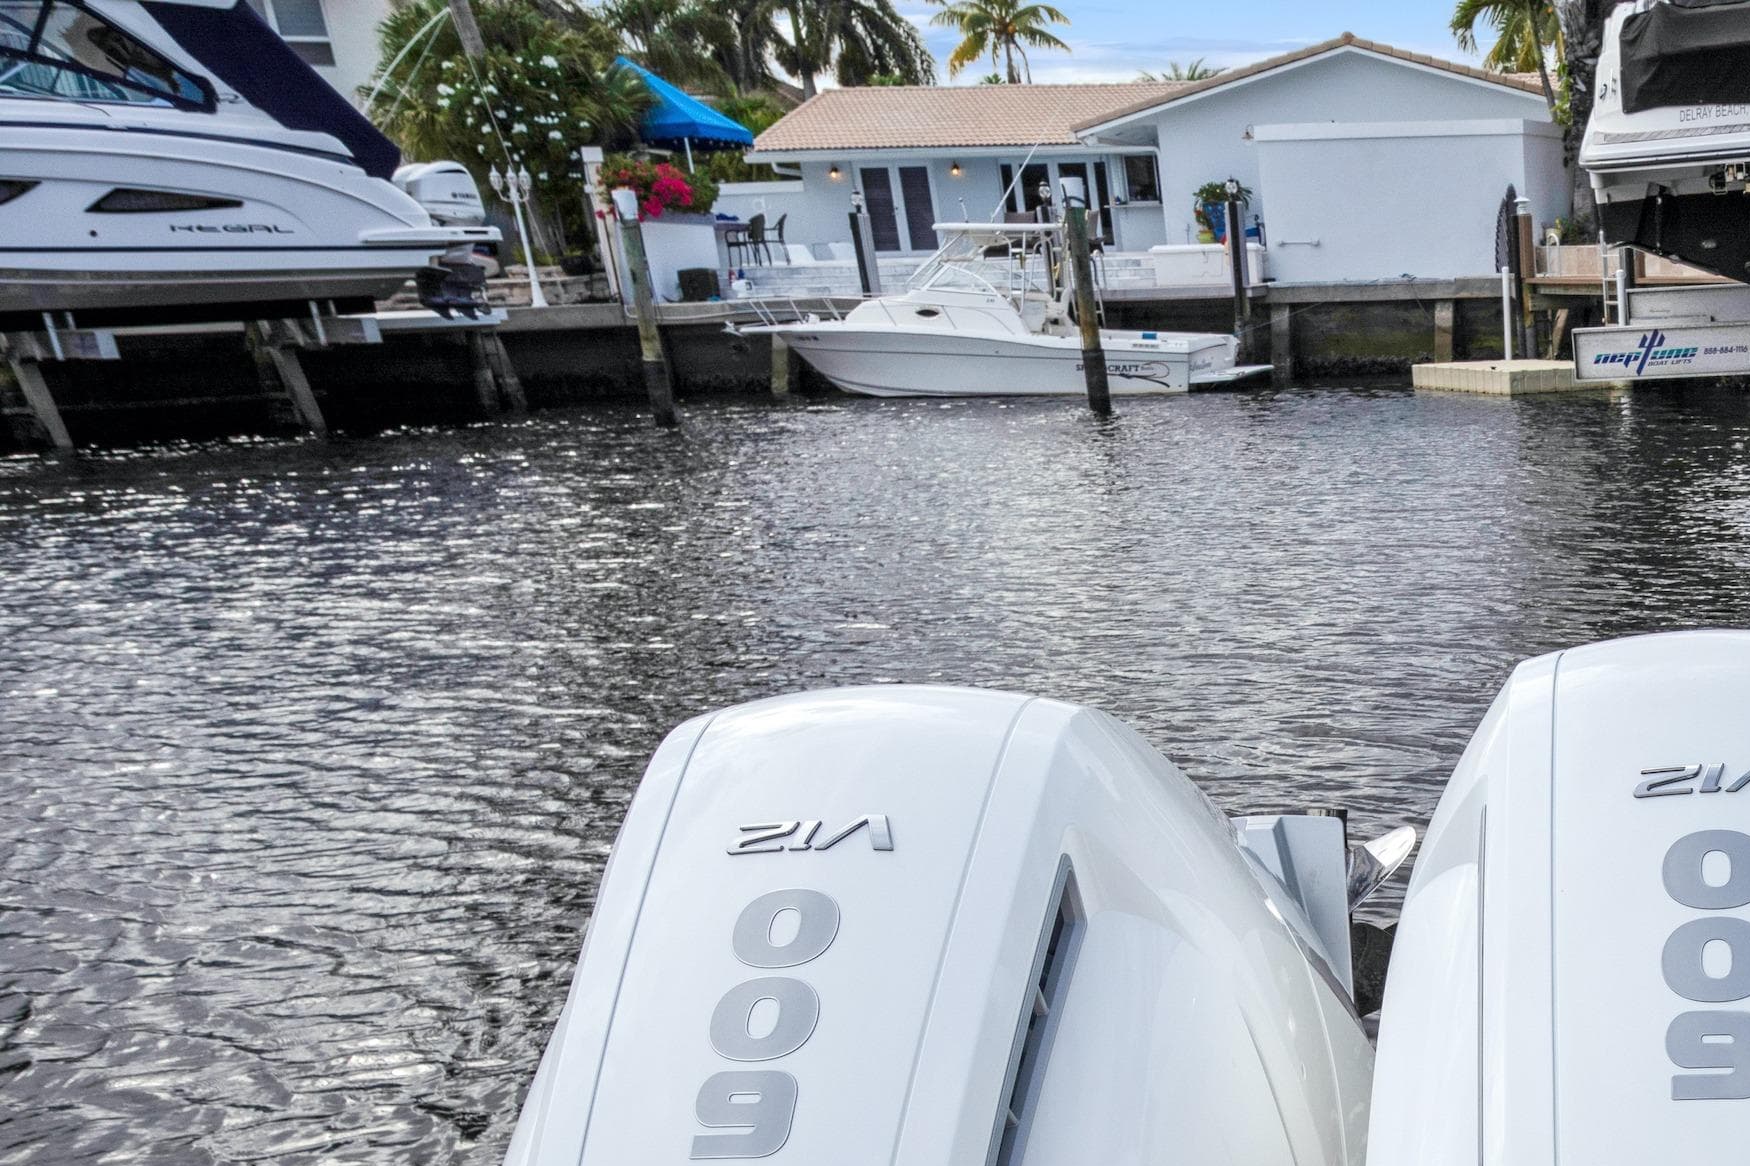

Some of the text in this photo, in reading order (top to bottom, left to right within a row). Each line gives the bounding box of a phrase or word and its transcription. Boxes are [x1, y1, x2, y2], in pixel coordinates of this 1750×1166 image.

[1680, 106, 1712, 122] DELRAY
[1715, 103, 1749, 117] BEACH,
[170, 224, 294, 233] REGAL
[1075, 364, 1140, 372] SCRAFT
[726, 814, 894, 855] V12
[689, 887, 841, 1160] 600
